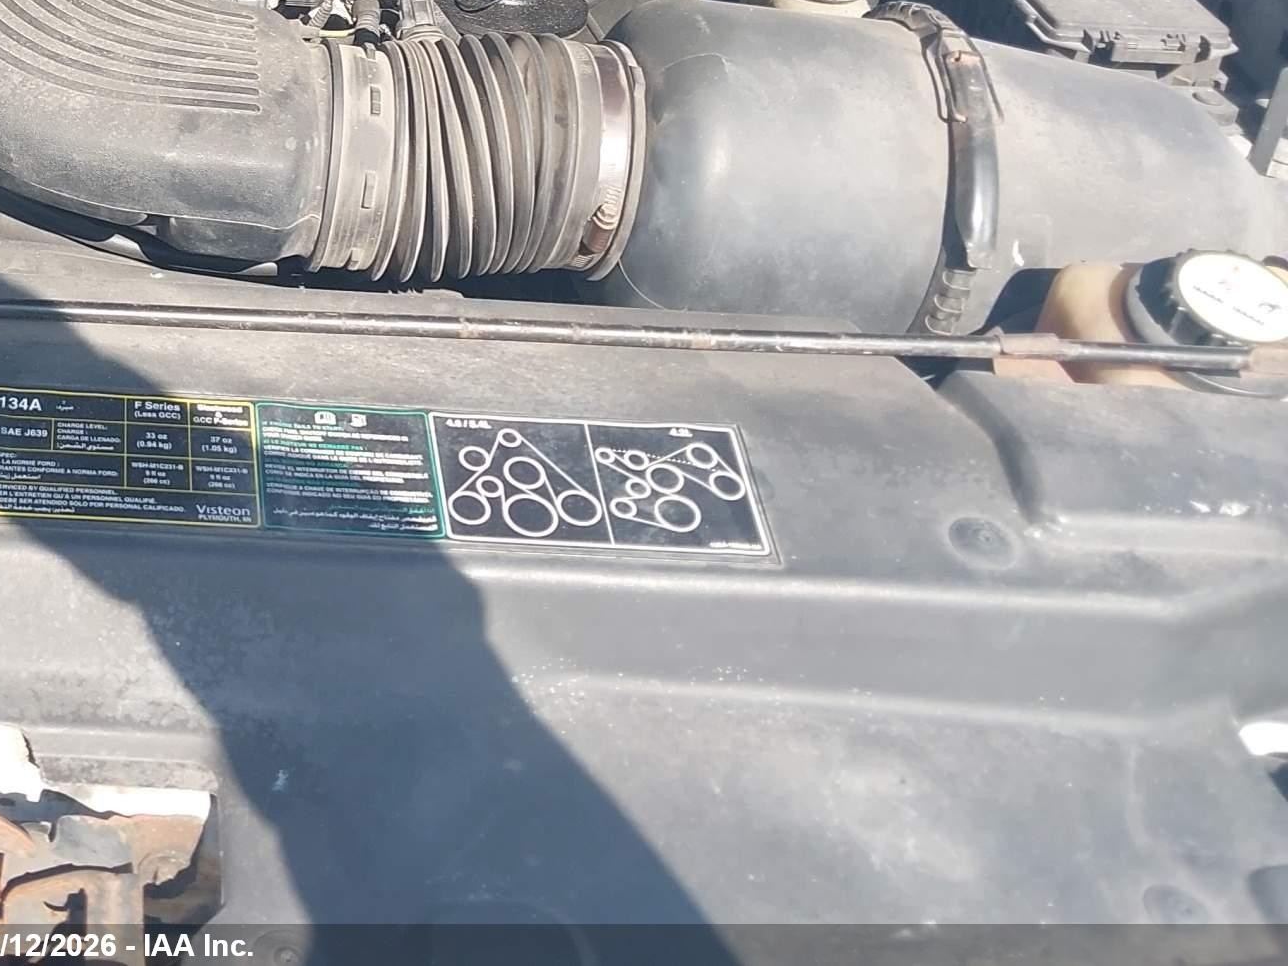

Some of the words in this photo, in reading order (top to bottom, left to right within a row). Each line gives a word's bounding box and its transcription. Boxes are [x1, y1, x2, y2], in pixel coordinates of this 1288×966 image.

[134, 401, 142, 409] F
[145, 401, 181, 412] Series
[134, 410, 157, 418] (Less
[0, 427, 22, 436] SAE
[24, 429, 48, 437] J639
[146, 432, 157, 440] 33
[158, 441, 172, 451] kg)
[280, 439, 308, 447] MOTEUR
[223, 445, 237, 454] kg)
[82, 494, 123, 502] PERSONNEL
[33, 498, 69, 506] ATENDIDO
[104, 502, 141, 510] PERSONAL
[195, 504, 251, 516] Visteon
